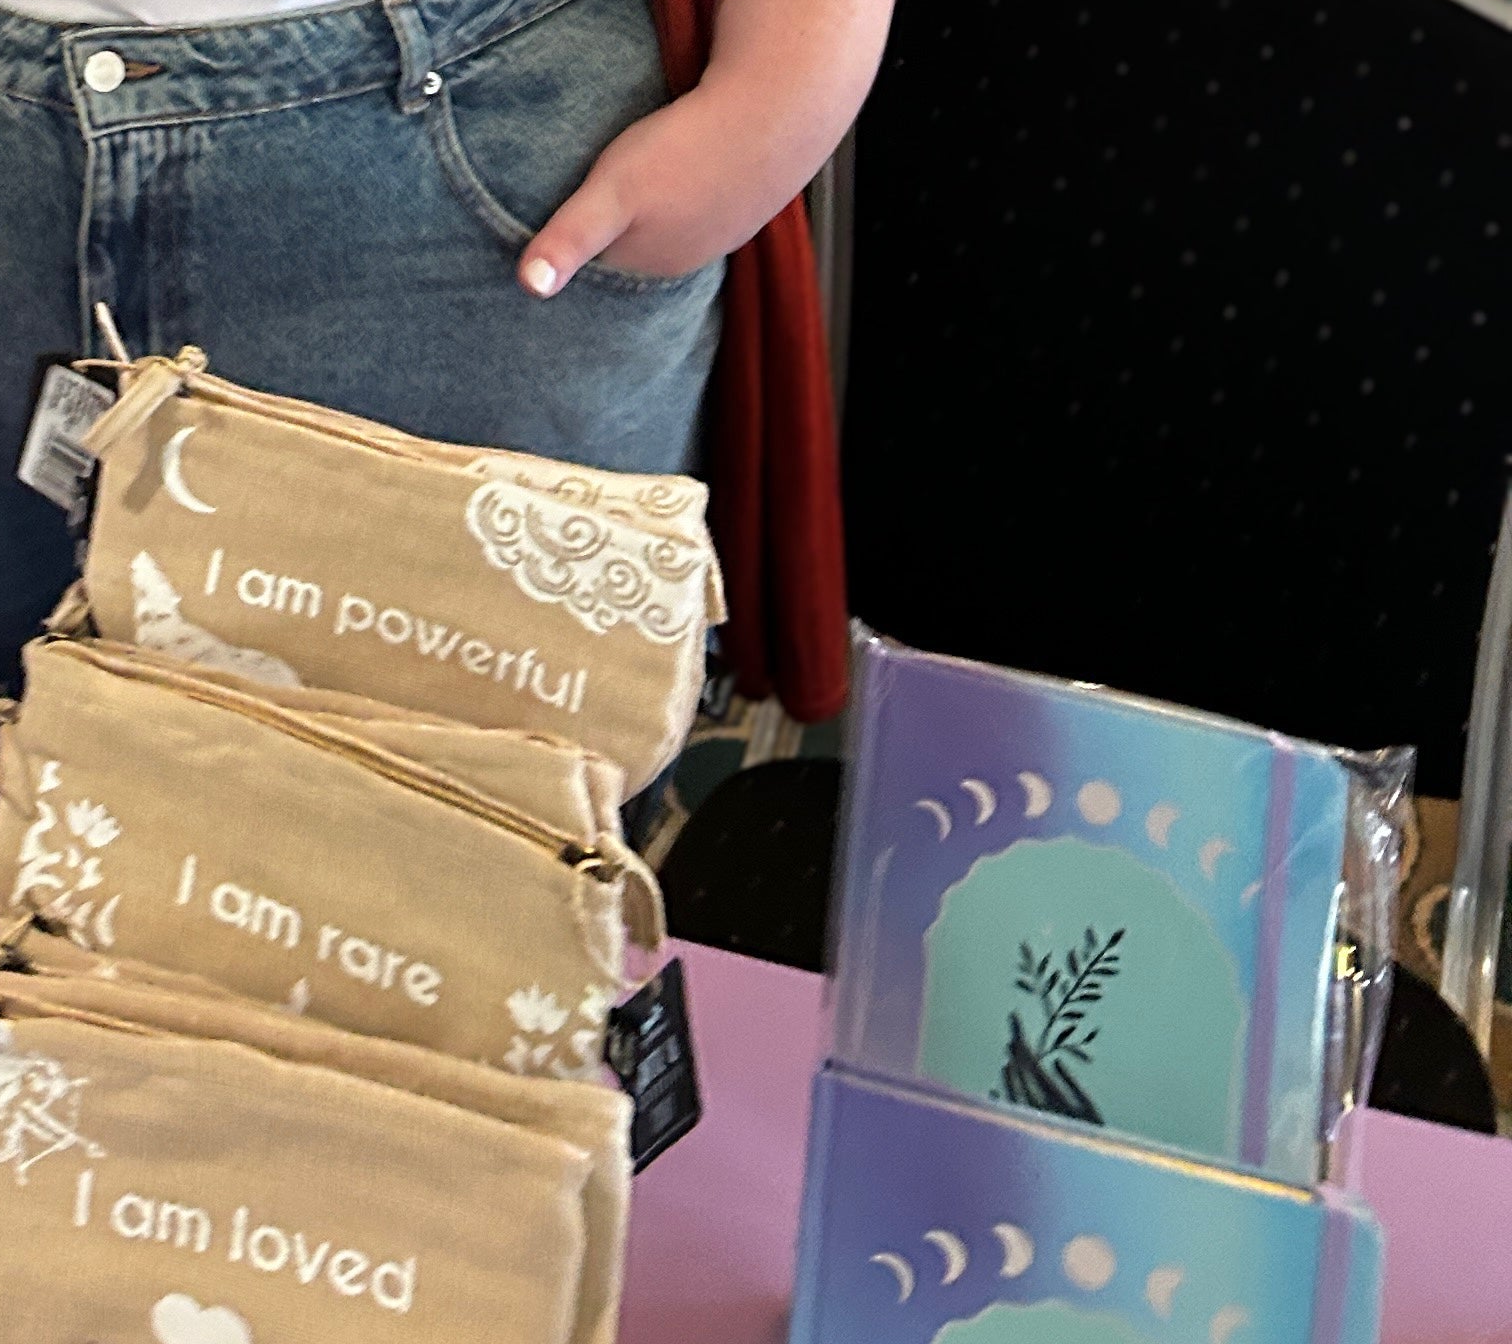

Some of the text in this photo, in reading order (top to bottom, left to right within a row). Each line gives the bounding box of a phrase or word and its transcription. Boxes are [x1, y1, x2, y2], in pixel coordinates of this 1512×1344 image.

[203, 547, 587, 713] I am powerful
[174, 853, 443, 1006] I am rare
[72, 1169, 417, 1314] I am loved
